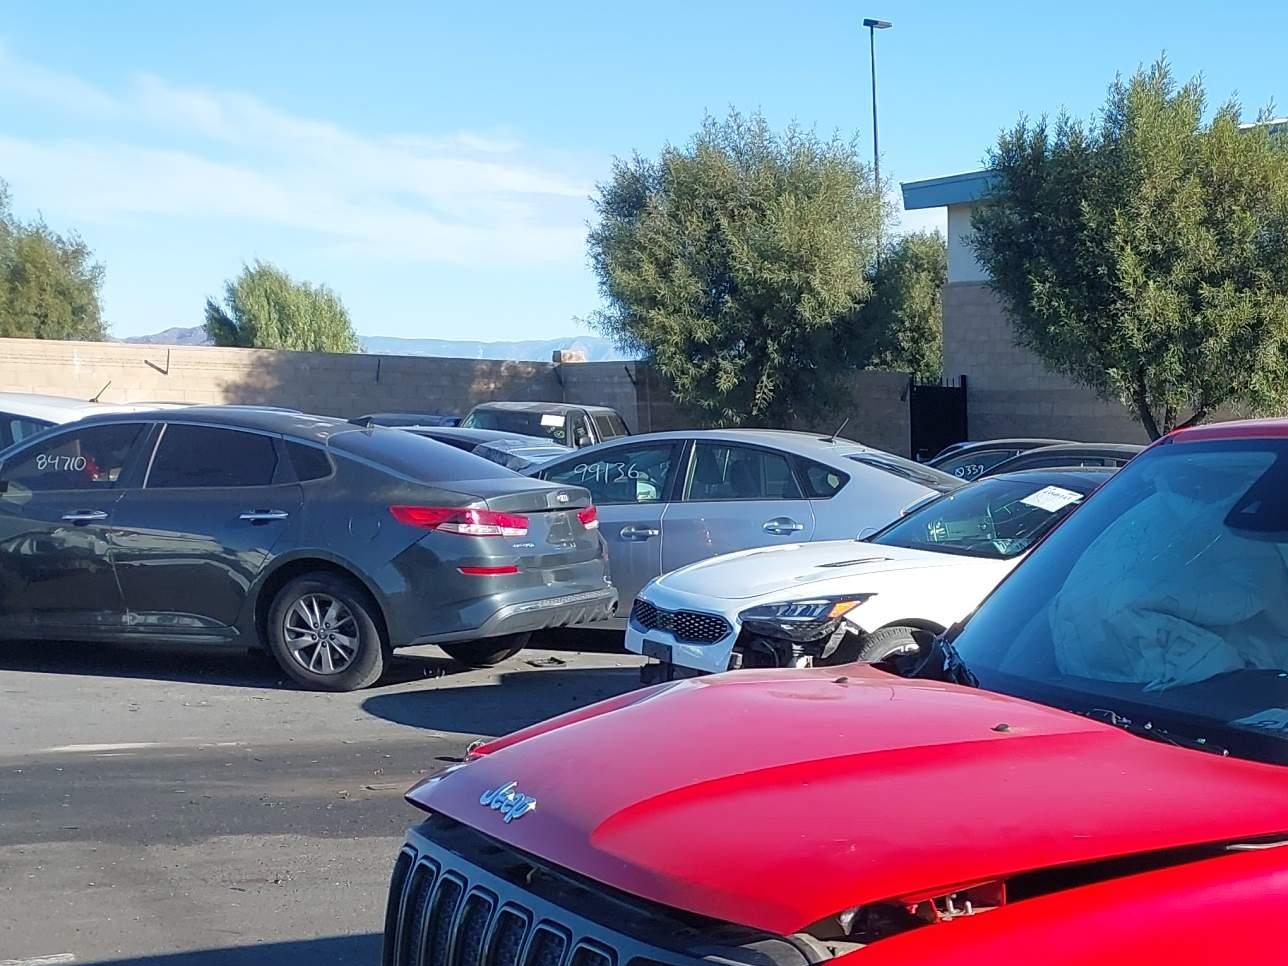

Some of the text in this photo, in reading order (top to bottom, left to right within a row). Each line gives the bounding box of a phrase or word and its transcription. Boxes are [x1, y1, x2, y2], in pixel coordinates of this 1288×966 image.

[36, 454, 87, 471] 84710
[574, 462, 640, 484] 99136
[480, 781, 536, 823] Jeep
